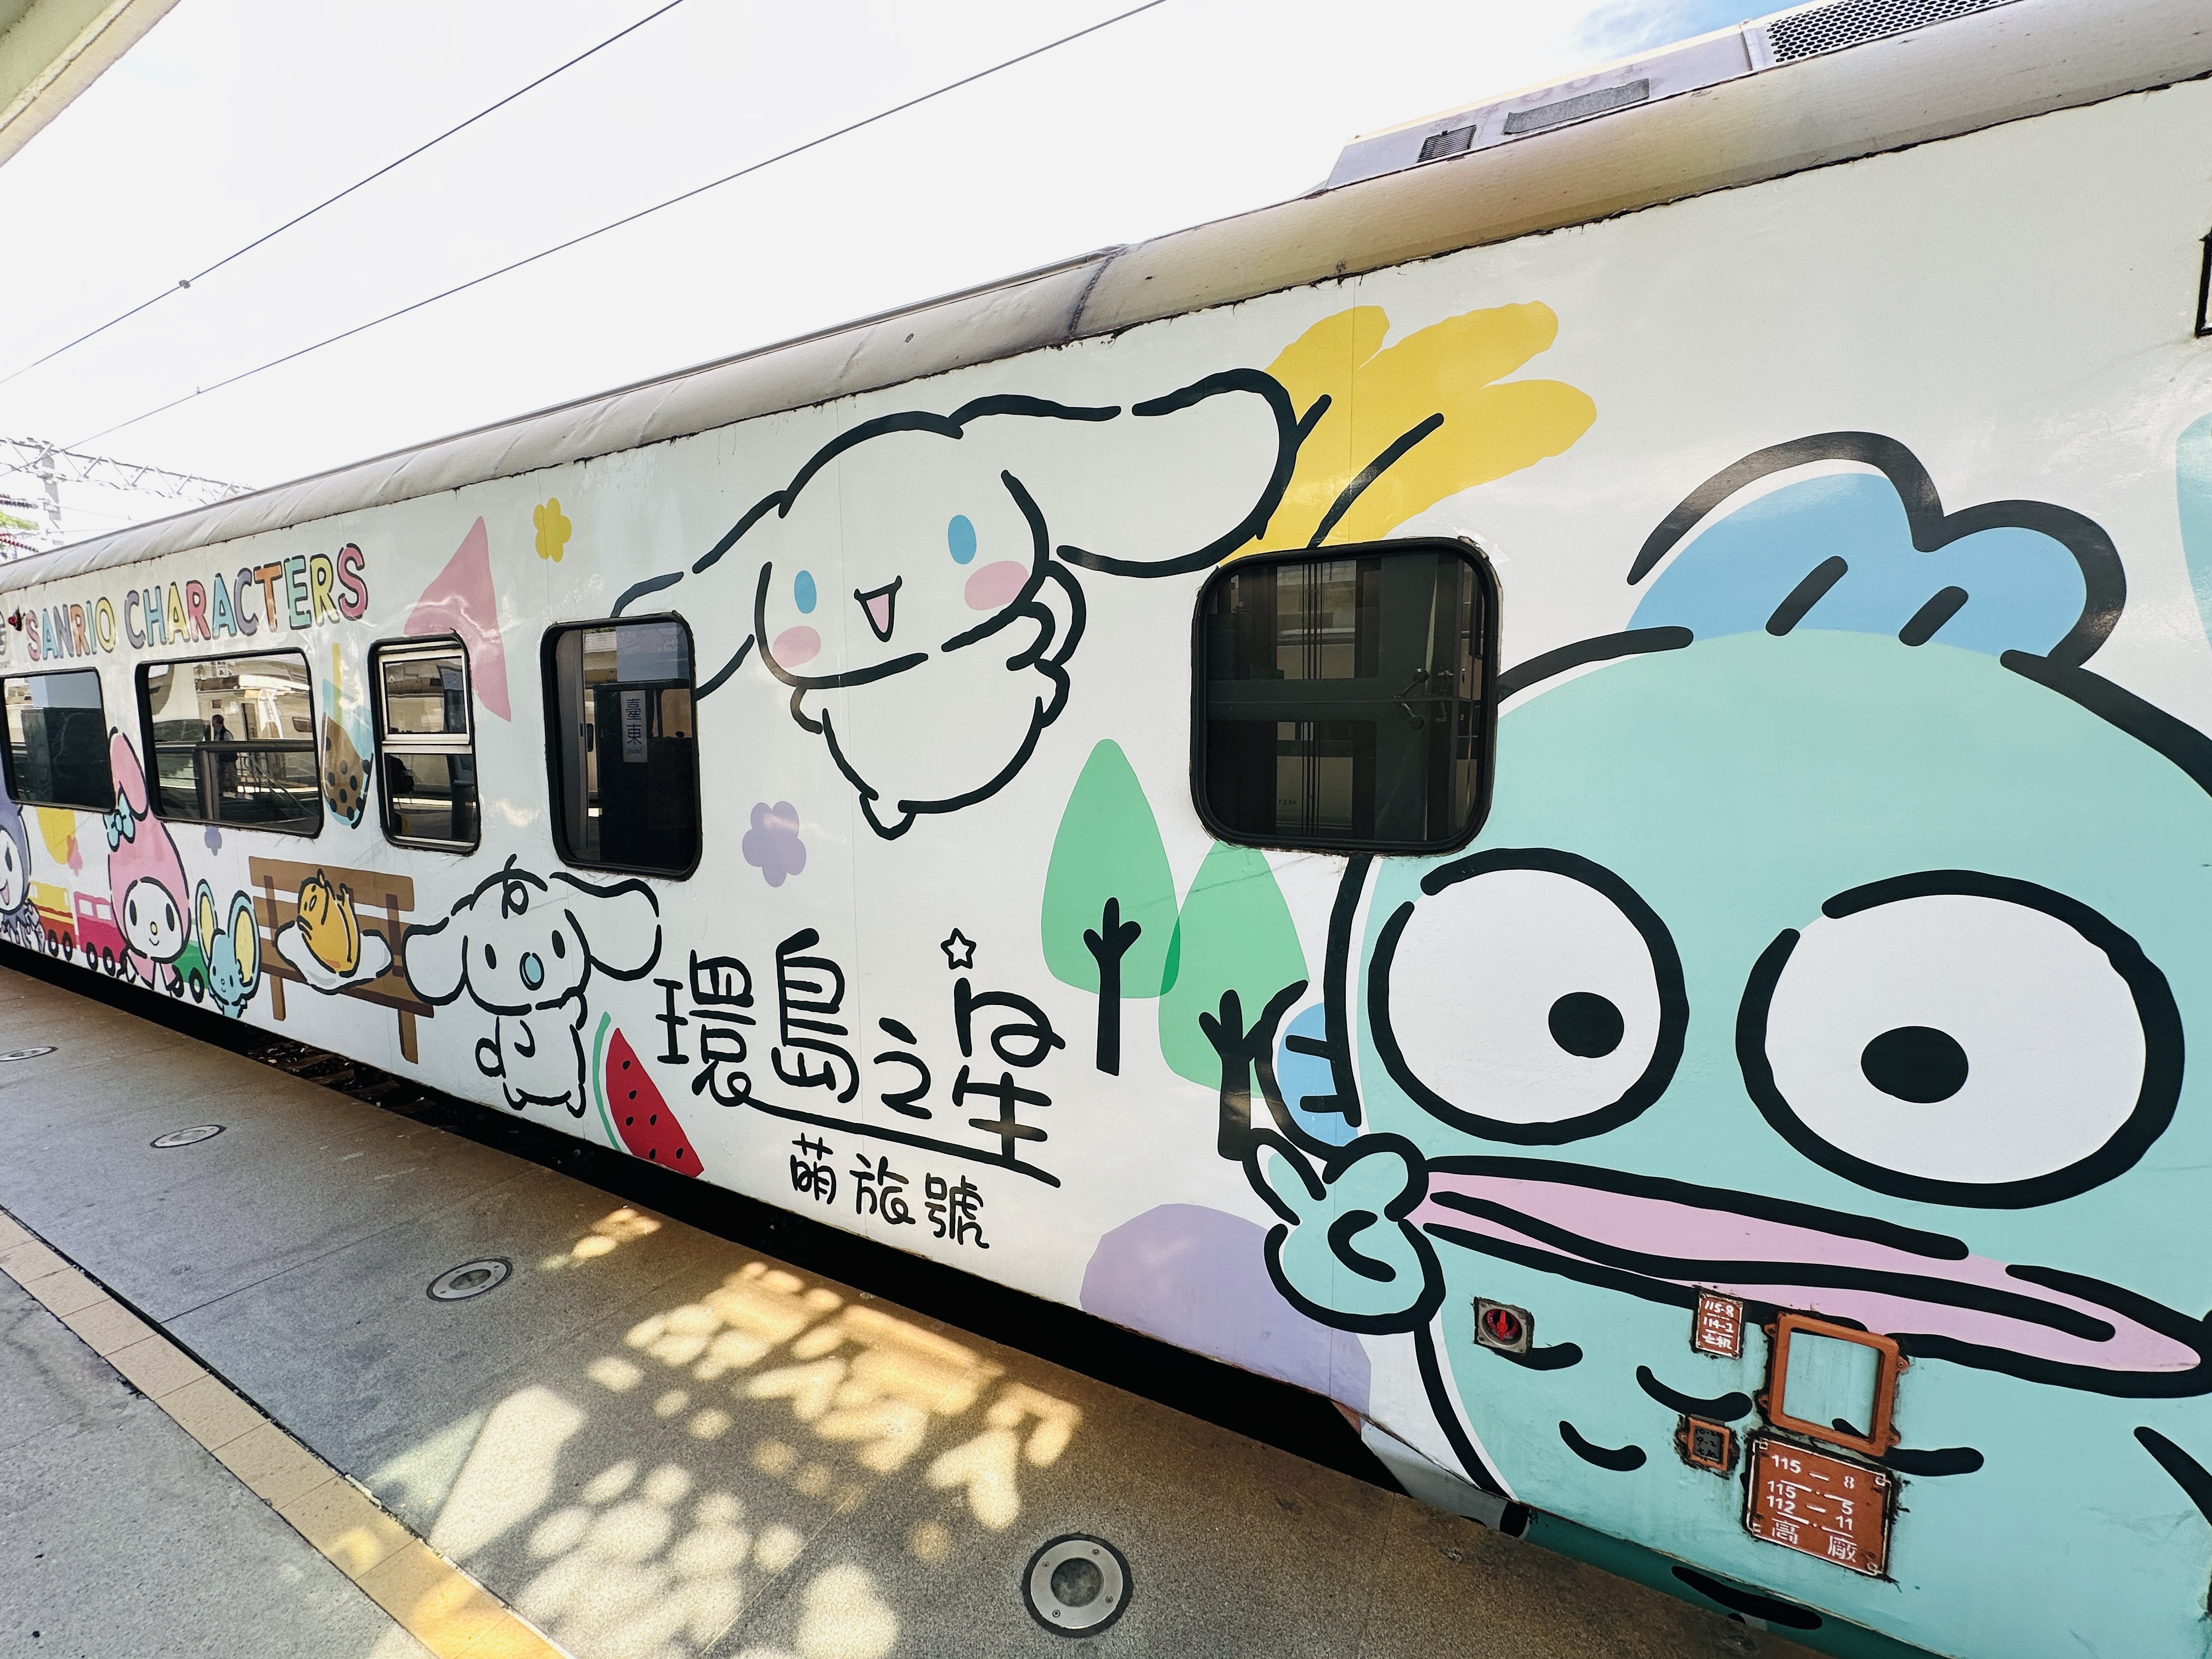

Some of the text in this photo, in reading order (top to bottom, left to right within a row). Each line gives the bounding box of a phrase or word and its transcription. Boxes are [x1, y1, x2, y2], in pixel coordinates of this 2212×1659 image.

[26, 596, 116, 662] SANRIO
[124, 543, 368, 649] CHARACTERS
[653, 928, 1066, 1189] 環島之星
[790, 1133, 990, 1249] 萌旅號
[1767, 1480, 1853, 1515] 115 5
[1771, 1454, 1802, 1474] 115
[1844, 1476, 1855, 1489] 8
[1766, 1495, 1796, 1514] 112
[1835, 1515, 1853, 1531] 11
